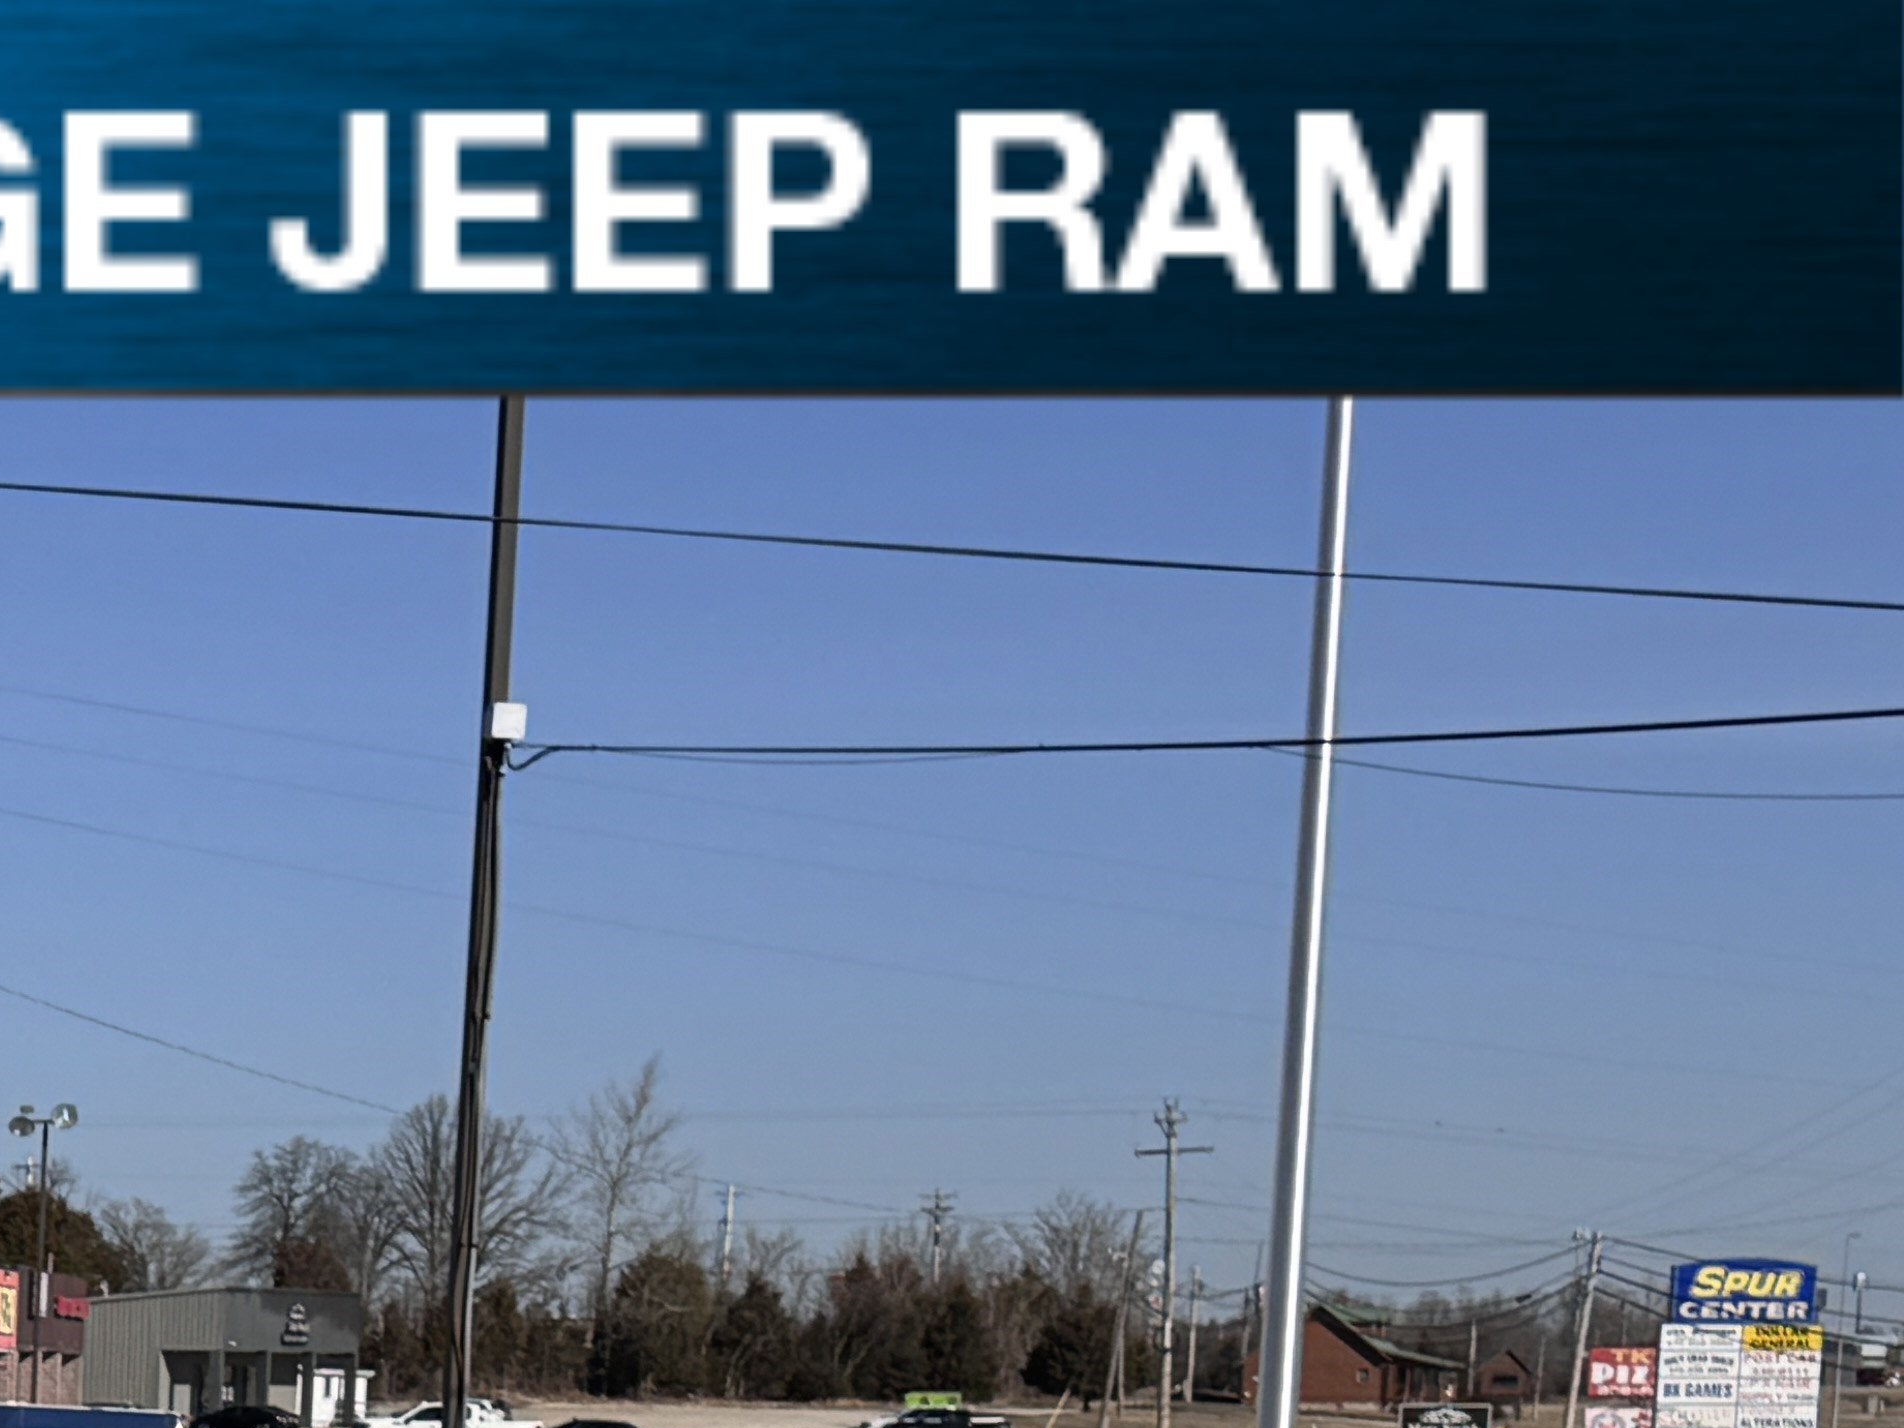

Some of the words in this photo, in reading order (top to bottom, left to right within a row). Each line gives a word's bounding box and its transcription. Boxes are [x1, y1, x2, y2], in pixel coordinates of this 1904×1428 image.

[1690, 1266, 1805, 1298] SPUR
[1679, 1301, 1809, 1319] CENTER
[1591, 1362, 1649, 1384] PIZ
[1685, 1382, 1732, 1397] GAMES
